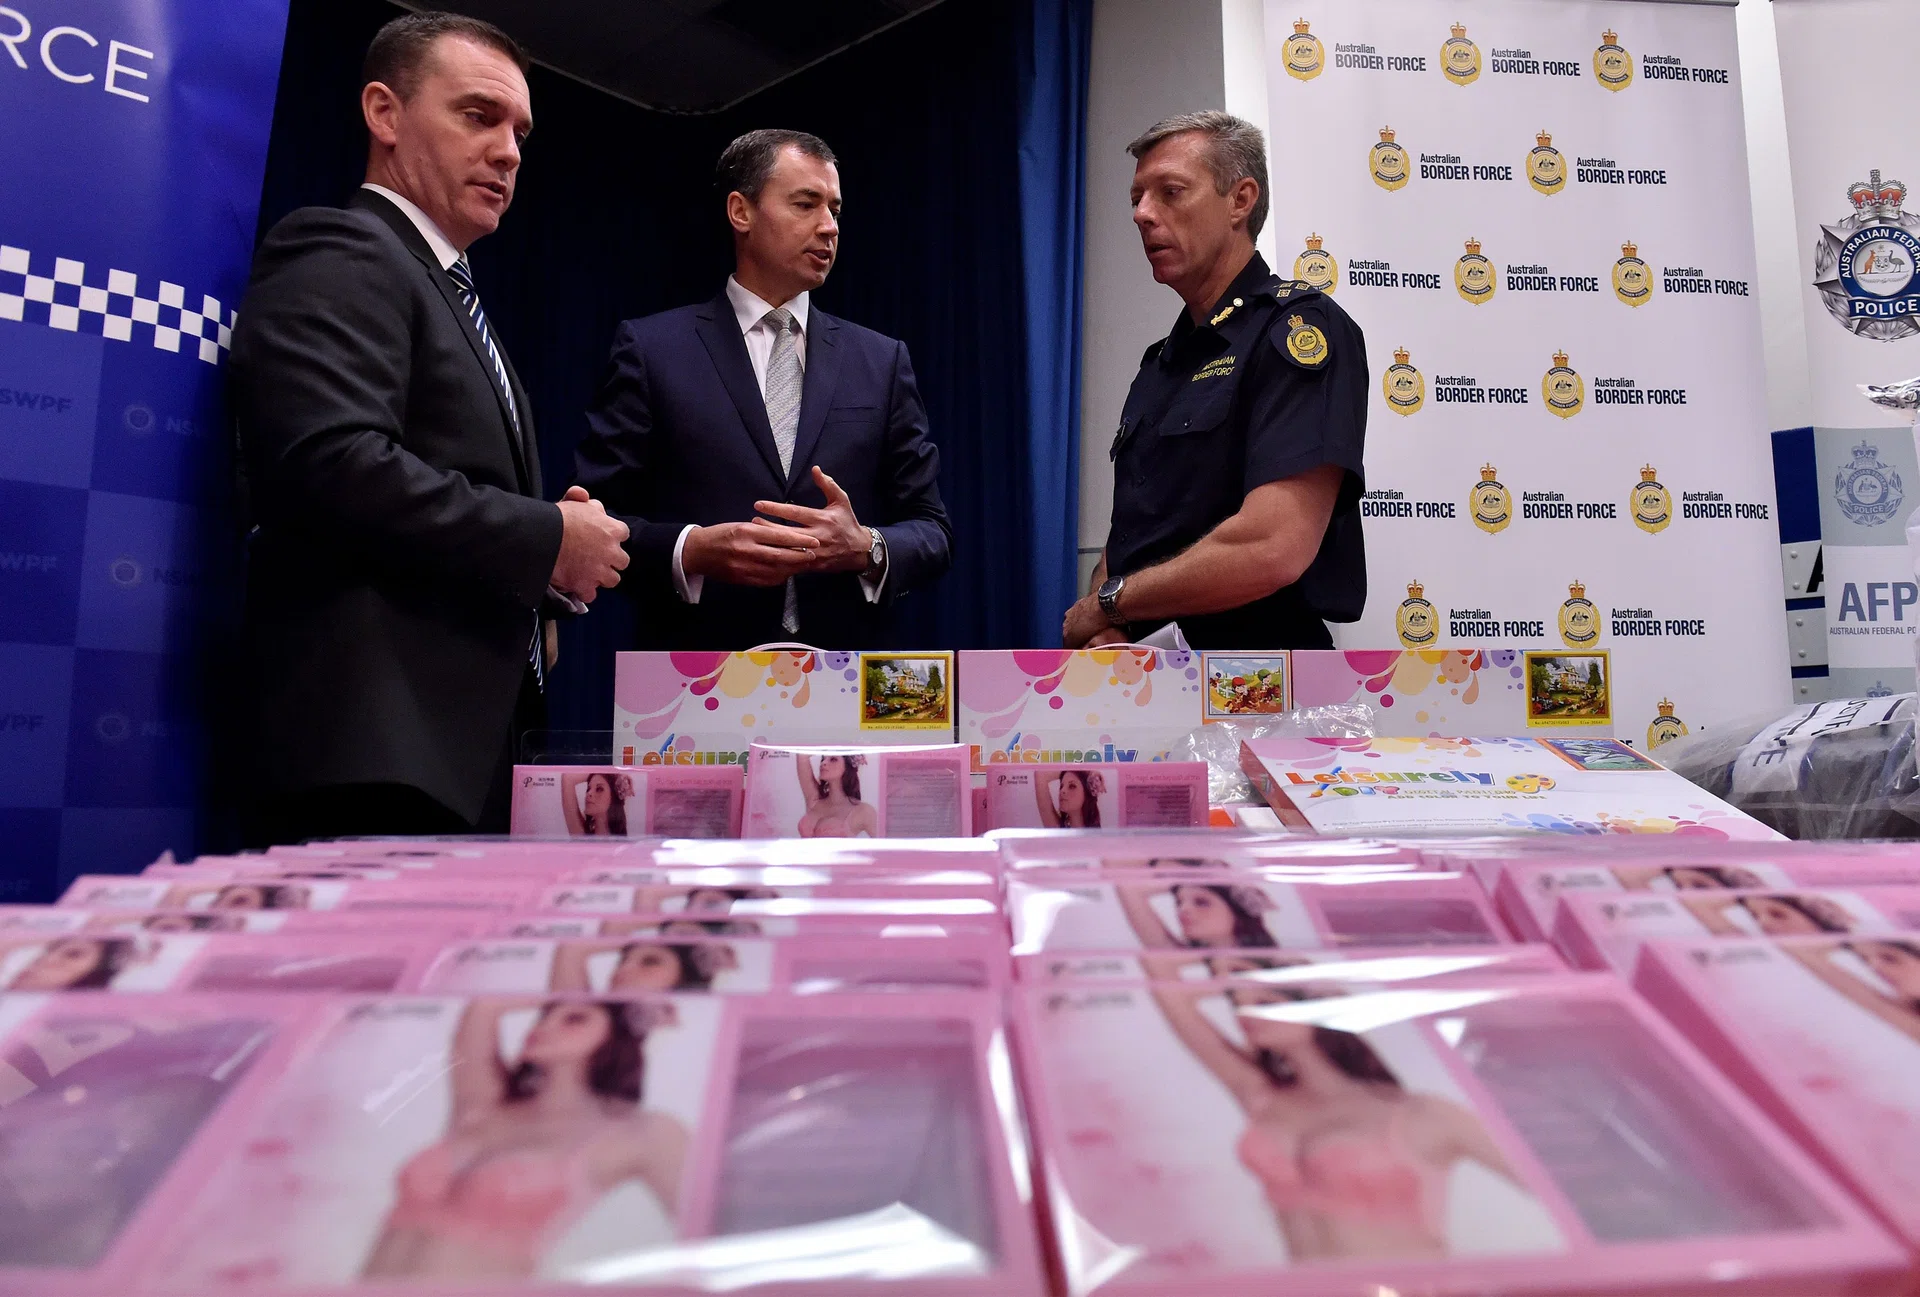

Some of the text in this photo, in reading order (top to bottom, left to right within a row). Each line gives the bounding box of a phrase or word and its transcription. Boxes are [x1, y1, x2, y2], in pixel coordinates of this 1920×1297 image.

[1335, 43, 1375, 54] Australian
[1492, 49, 1531, 58] Australian
[1335, 54, 1427, 72] BORDER FORCE
[1492, 59, 1580, 76] BORDER FORCE
[1643, 55, 1681, 65] Australian
[1644, 65, 1728, 83] BORDER FORCE
[1420, 153, 1460, 163] Australian
[1577, 157, 1615, 168] Australian
[1421, 165, 1512, 180] BORDER FORCE
[1577, 169, 1666, 184] BORDER FORCE
[1842, 229, 1890, 279] AUSTRALIAN
[1349, 259, 1389, 270] Australian
[1507, 265, 1547, 274] Australian
[1664, 267, 1703, 277] Australian
[1349, 271, 1441, 289] BORDER FORCE
[1507, 276, 1599, 291] BORDER FORCE
[1664, 279, 1749, 296] BORDER FORCE
[1855, 299, 1918, 316] POLICE
[1435, 375, 1476, 386] Australian
[1595, 377, 1634, 387] Australian
[1436, 387, 1528, 403] BORDER FORCE
[1595, 389, 1686, 404] BORDER FORCE
[1362, 489, 1404, 500] Australian
[1523, 491, 1564, 501] Australian
[1683, 491, 1723, 501] Australian
[1362, 501, 1456, 519] BORDER FORCE
[1523, 503, 1616, 518] BORDER FORCE
[1683, 503, 1768, 519] BORDER FORCE
[1854, 505, 1884, 514] POLICE
[1838, 582, 1919, 621] AFP
[1450, 609, 1491, 619] Australian
[1612, 608, 1652, 618] Australian
[1450, 621, 1544, 637] BORDER FORCE
[1612, 620, 1705, 636] BORDER FORCE
[1829, 626, 1870, 635] AUSTRALIAN
[1871, 626, 1905, 635] FEDERAL
[1285, 770, 1495, 786] Leisurely
